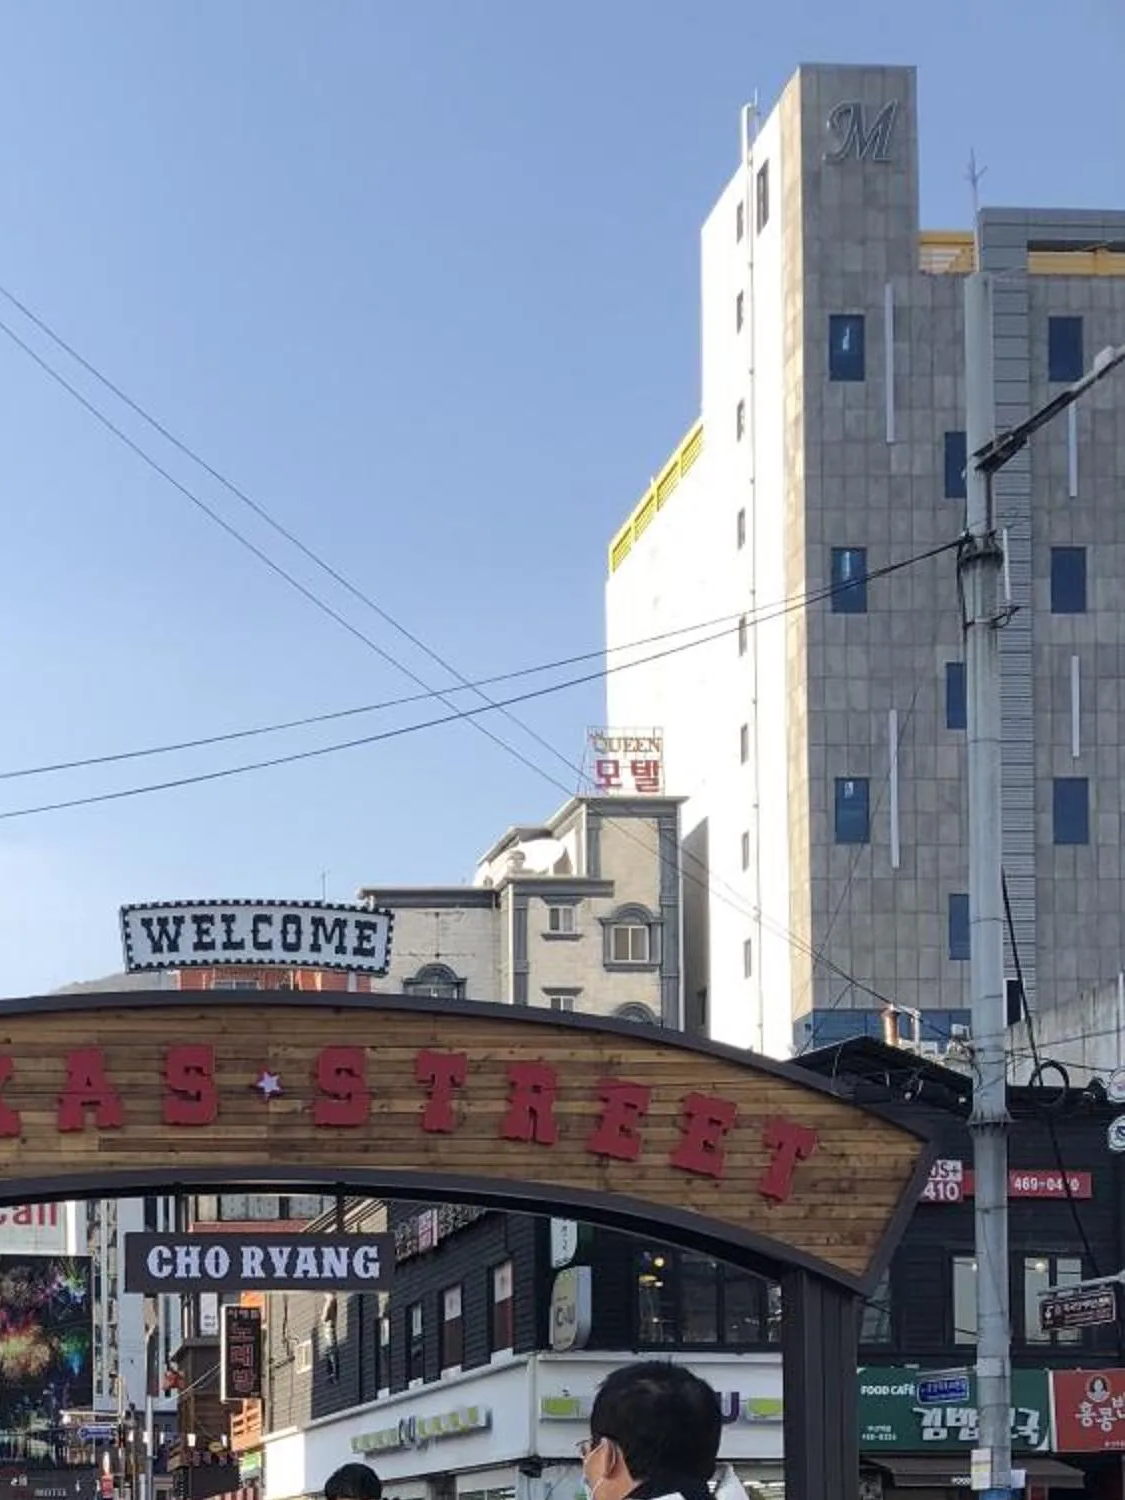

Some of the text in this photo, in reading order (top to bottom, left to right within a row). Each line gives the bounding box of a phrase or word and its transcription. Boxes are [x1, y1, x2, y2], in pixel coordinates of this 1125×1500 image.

[823, 99, 898, 163] M
[592, 734, 661, 753] QUEEN
[594, 758, 660, 793] 모텔
[140, 911, 379, 959] WELCOME
[313, 1046, 818, 1202] STREET
[146, 1244, 381, 1280] CHO RYANG
[860, 1384, 890, 1395] FOOD
